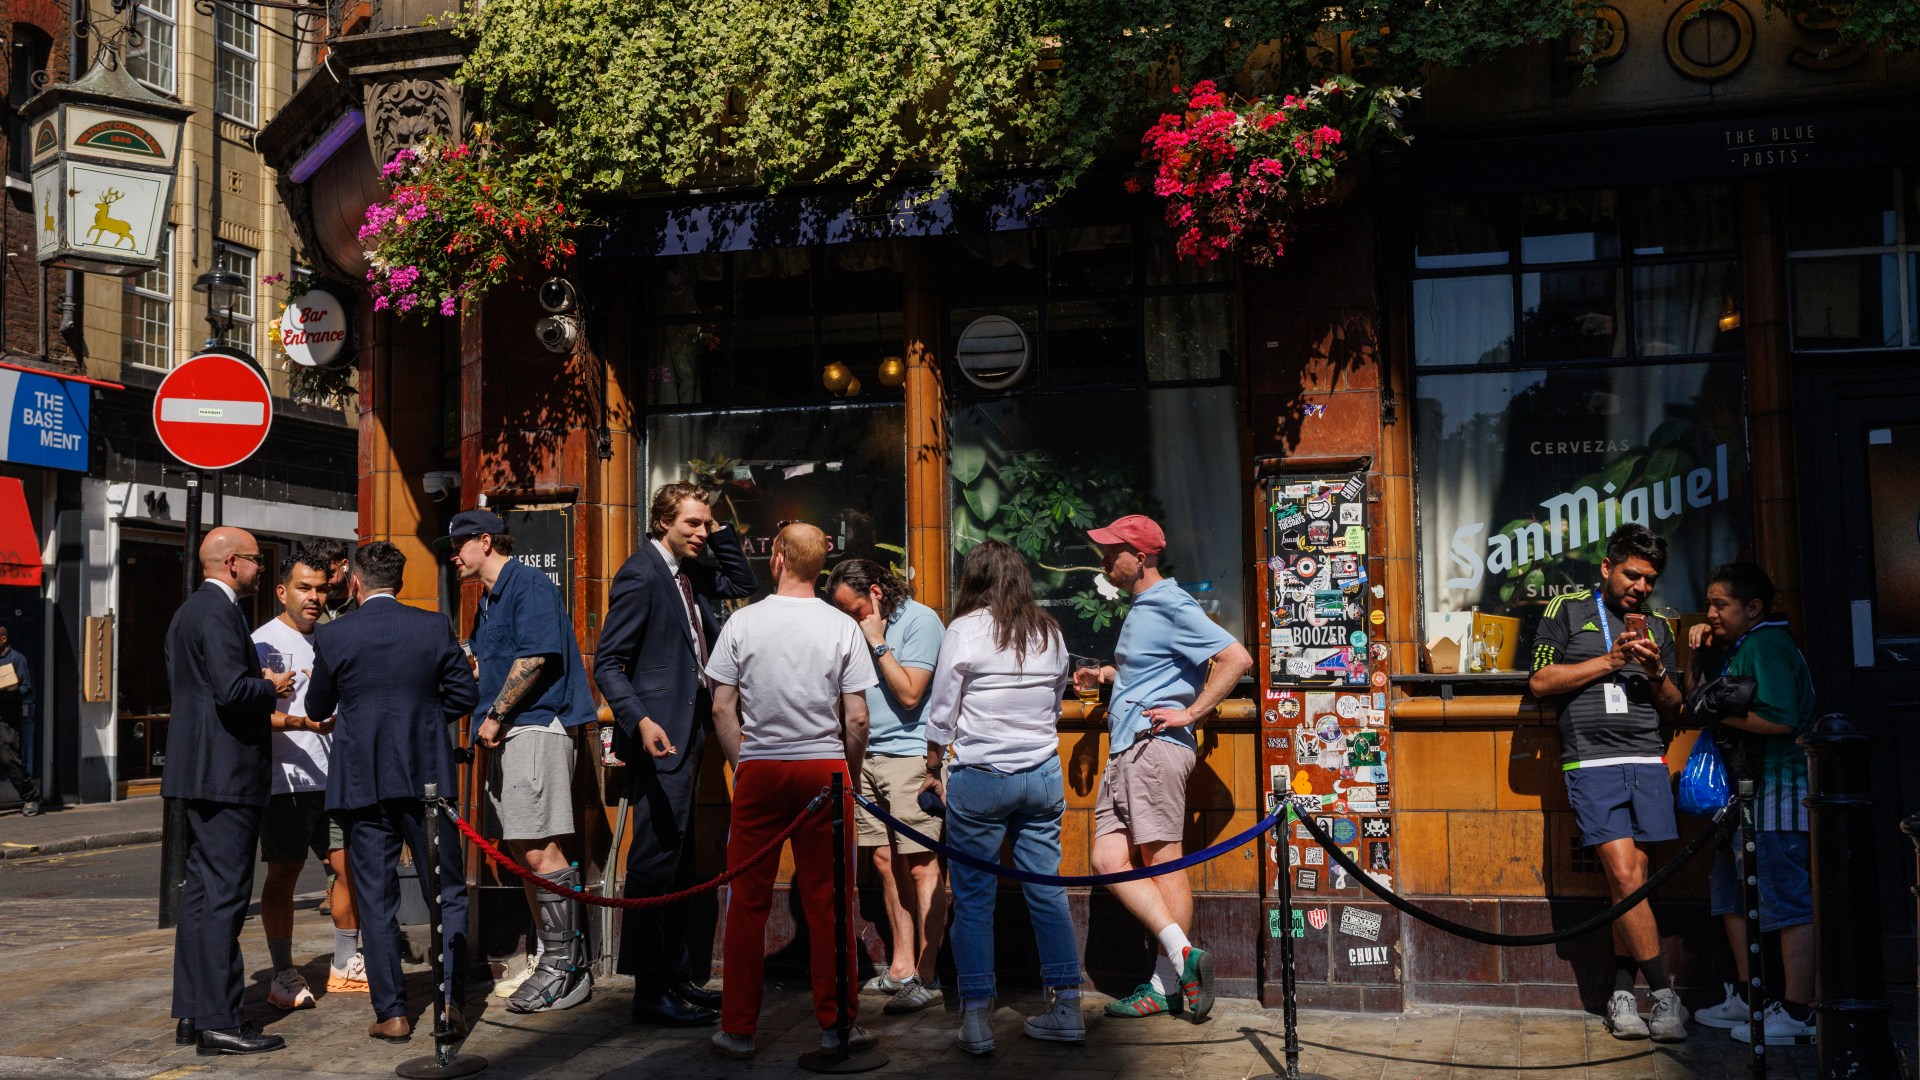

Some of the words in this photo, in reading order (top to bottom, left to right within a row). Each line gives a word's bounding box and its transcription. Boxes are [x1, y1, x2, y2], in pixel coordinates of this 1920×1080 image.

[1724, 129, 1756, 147] THE
[1771, 125, 1816, 142] BLUE
[1743, 150, 1798, 167] POSTS
[299, 307, 328, 325] Bar
[283, 328, 345, 347] Entrance
[34, 391, 64, 413] THE
[23, 407, 63, 430] BASE
[40, 429, 82, 452] MENT
[1530, 439, 1631, 456] CERVEZAS
[508, 555, 542, 568] EASE
[544, 554, 557, 568] BE
[1292, 625, 1347, 646] BOOZER
[1348, 946, 1388, 963] CHUKY
